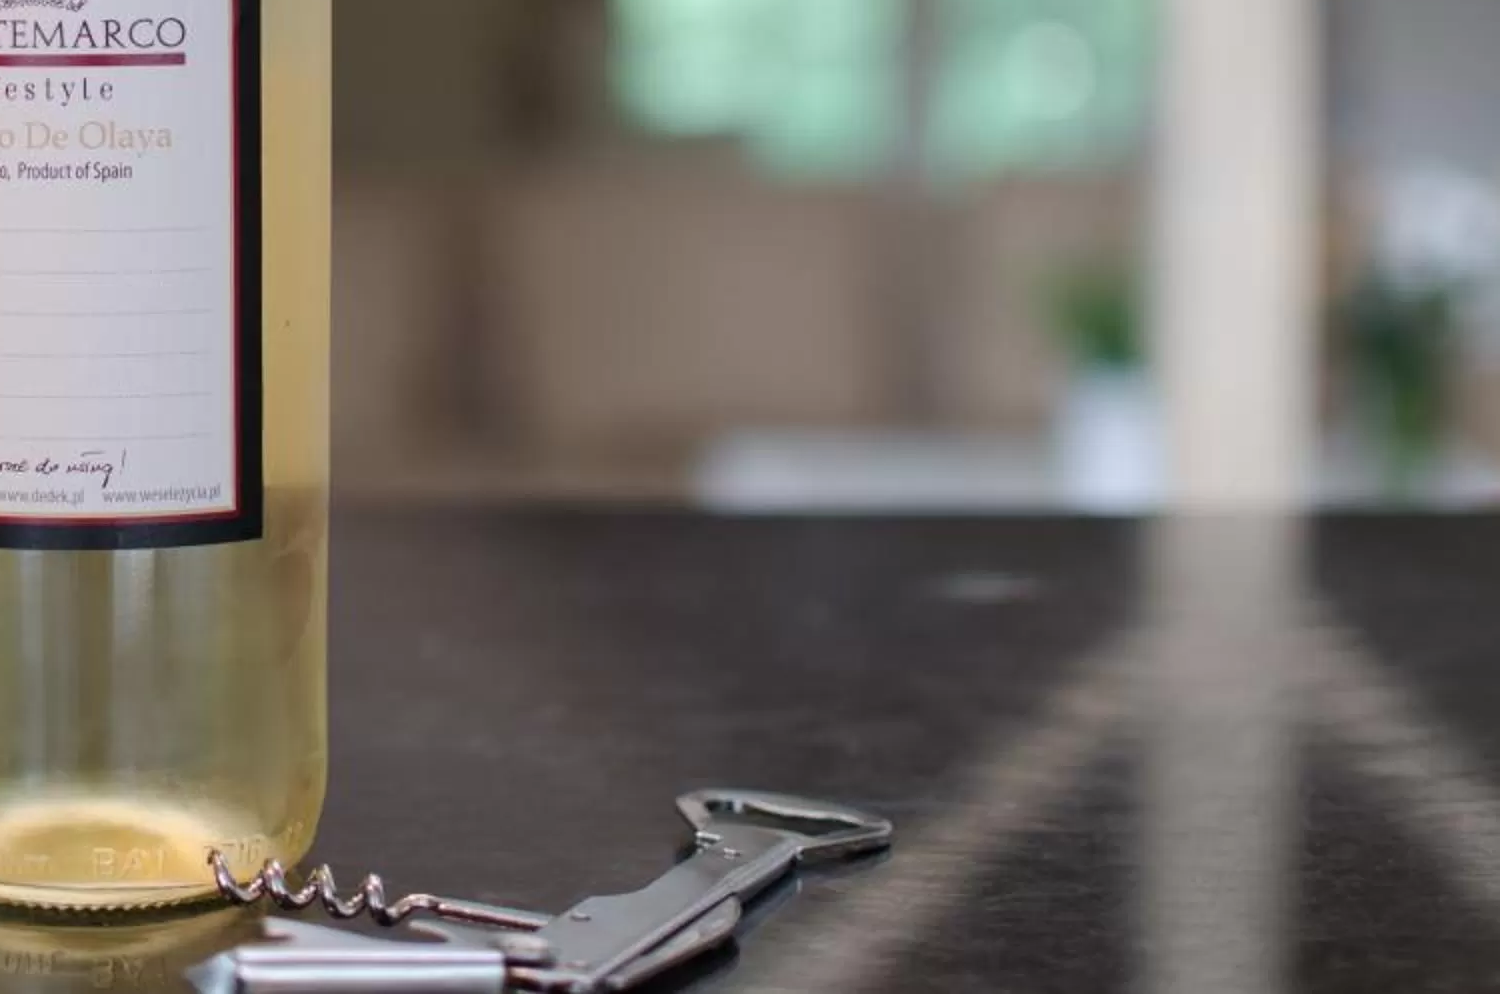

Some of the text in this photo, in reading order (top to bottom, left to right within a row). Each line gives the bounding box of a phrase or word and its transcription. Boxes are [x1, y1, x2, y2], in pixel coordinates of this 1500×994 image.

[25, 120, 69, 150] De
[79, 119, 173, 158] Olaya
[17, 161, 71, 180] Product
[75, 160, 91, 180] of
[92, 160, 133, 183] Spain
